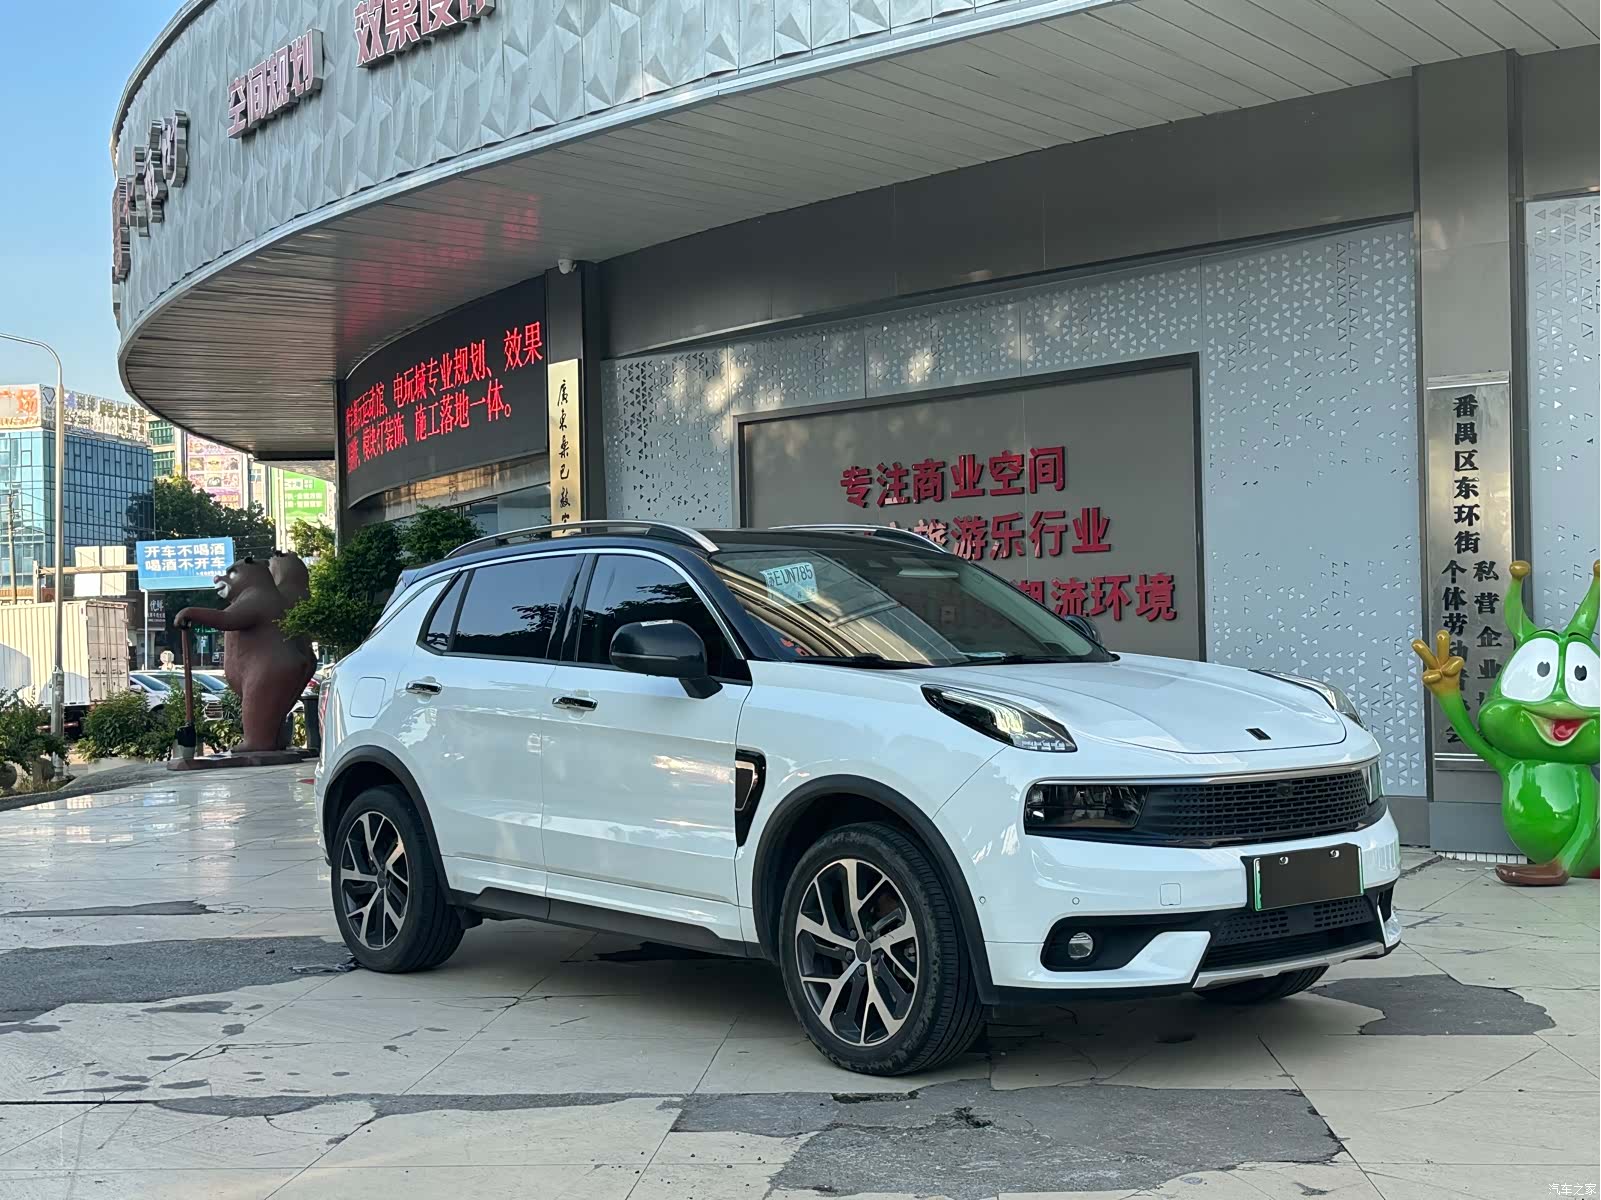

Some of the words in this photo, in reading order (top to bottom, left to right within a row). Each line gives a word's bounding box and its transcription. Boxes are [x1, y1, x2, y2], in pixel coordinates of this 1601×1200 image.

[354, 0, 488, 67] 效果设
[227, 28, 314, 138] 空间规划
[841, 446, 1066, 508] 专注商业空间
[1453, 393, 1481, 555] 番禺区东环街
[144, 542, 225, 558] 开车不喝酒
[145, 557, 226, 572] 喝酒不开车
[864, 507, 1112, 561] 旅游乐行业
[1473, 560, 1503, 706] 私营企业
